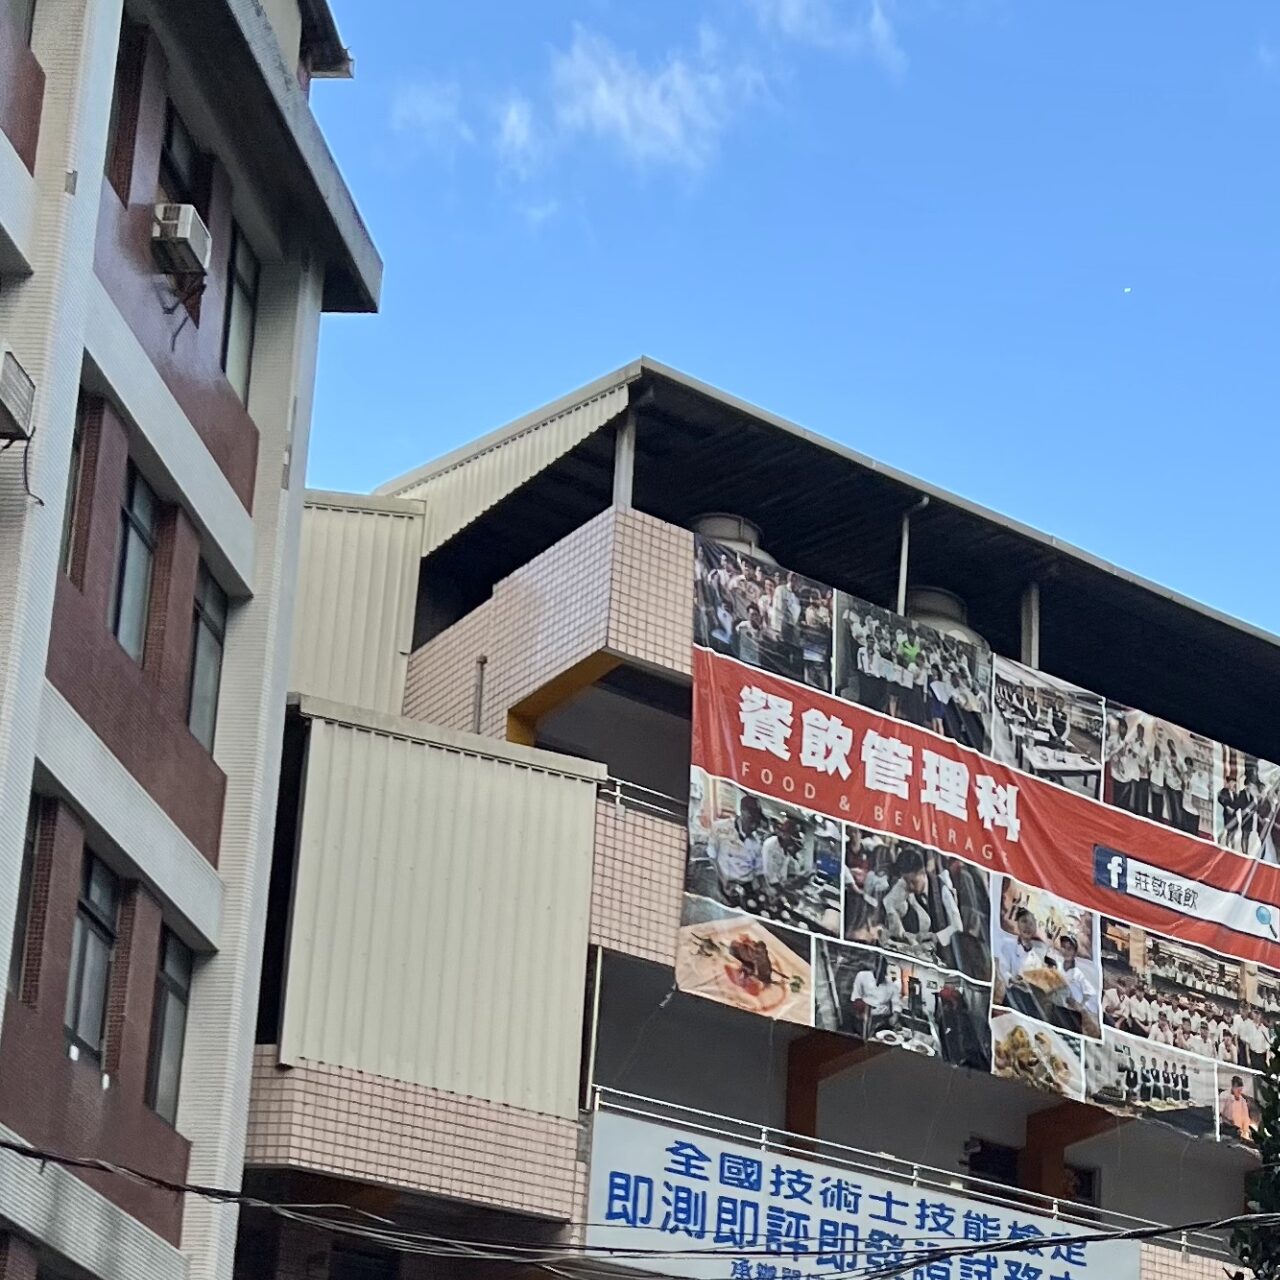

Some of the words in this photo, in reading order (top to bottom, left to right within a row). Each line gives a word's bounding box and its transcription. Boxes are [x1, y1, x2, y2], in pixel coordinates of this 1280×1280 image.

[738, 684, 1022, 843] 餐飲管理科
[741, 760, 817, 800] FOOD
[838, 794, 851, 811] &
[1134, 870, 1200, 912] 莊敬餐飲
[663, 1139, 1088, 1267] 全國技術士技能檢定
